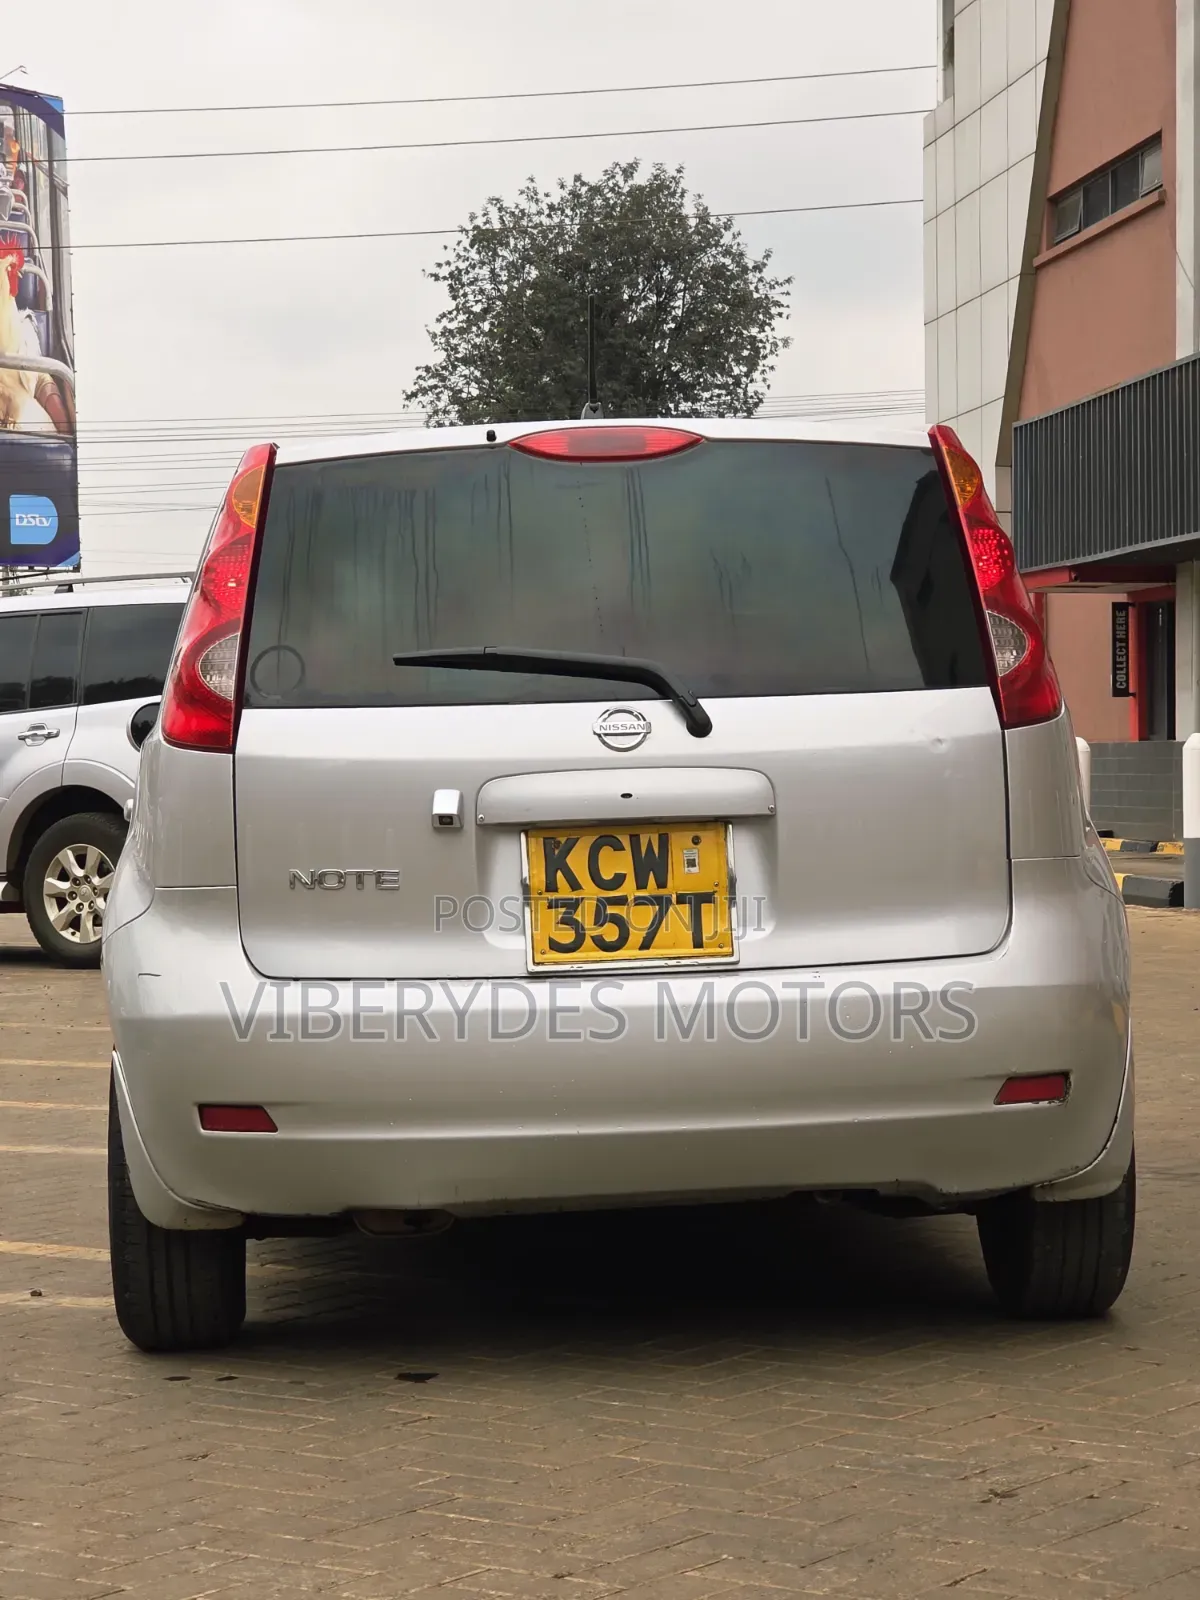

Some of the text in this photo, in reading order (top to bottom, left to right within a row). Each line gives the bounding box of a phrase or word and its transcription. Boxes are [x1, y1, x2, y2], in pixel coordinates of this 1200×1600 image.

[15, 513, 52, 527] DStv
[1115, 609, 1127, 689] COLLECT HERE
[599, 723, 646, 731] NISSAN
[289, 868, 400, 891] NOTE
[542, 832, 670, 893] KCW
[546, 890, 718, 954] 357T
